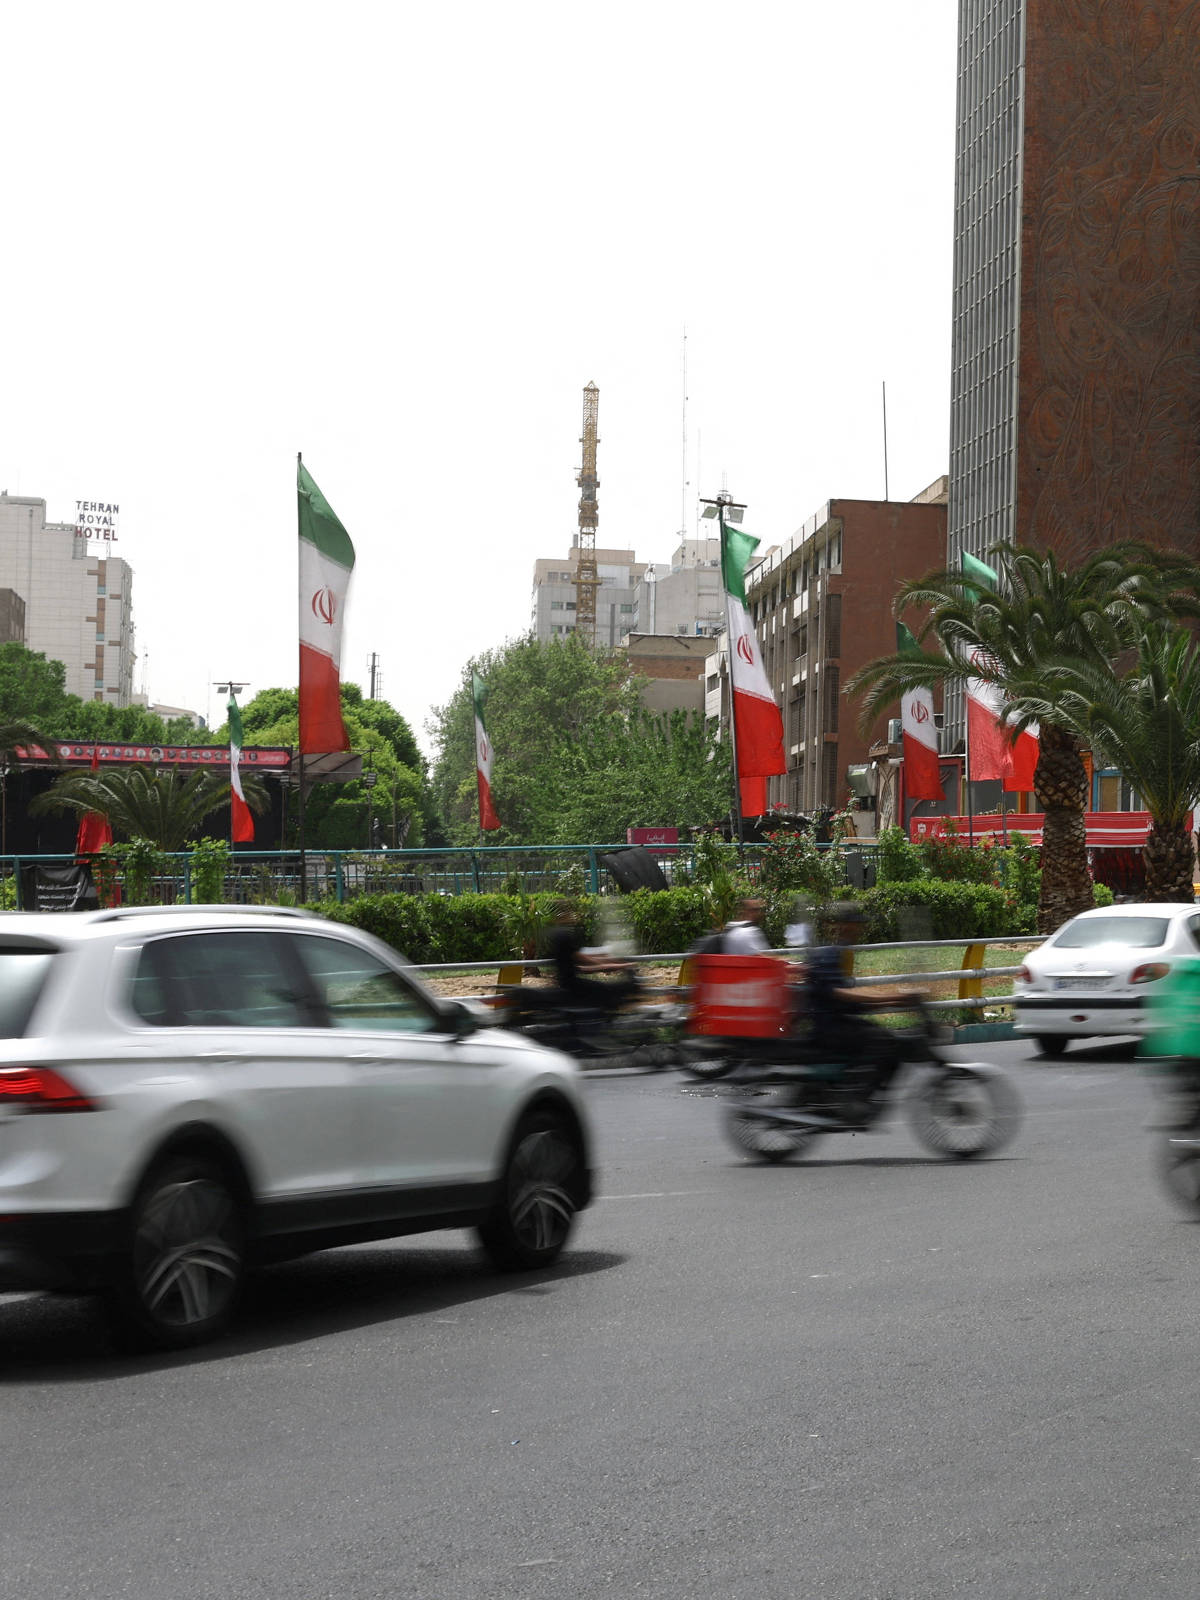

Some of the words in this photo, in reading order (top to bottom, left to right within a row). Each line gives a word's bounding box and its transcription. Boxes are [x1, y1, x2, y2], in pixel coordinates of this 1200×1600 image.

[75, 501, 120, 514] TEHRAN
[79, 514, 116, 526] ROYAL
[74, 526, 119, 541] HOTEL
